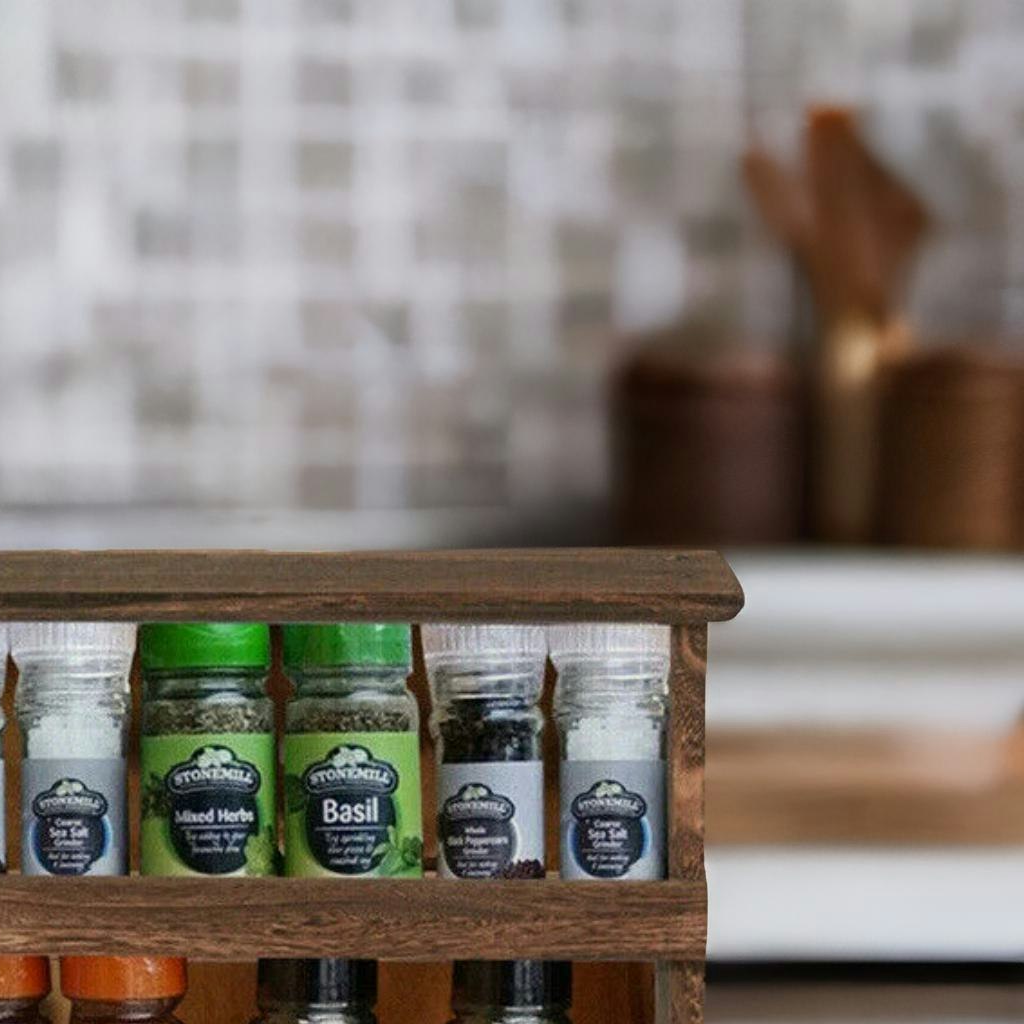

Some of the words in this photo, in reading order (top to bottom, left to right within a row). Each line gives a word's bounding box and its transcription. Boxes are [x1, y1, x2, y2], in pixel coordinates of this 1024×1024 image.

[174, 767, 253, 787] STONEMILL
[309, 767, 390, 786] STONEMILL
[218, 808, 254, 823] Herbs
[323, 797, 379, 824] Basil
[49, 826, 68, 839] Sea
[70, 826, 89, 839] Salt
[587, 828, 607, 840] Sea
[608, 828, 628, 840] Salt
